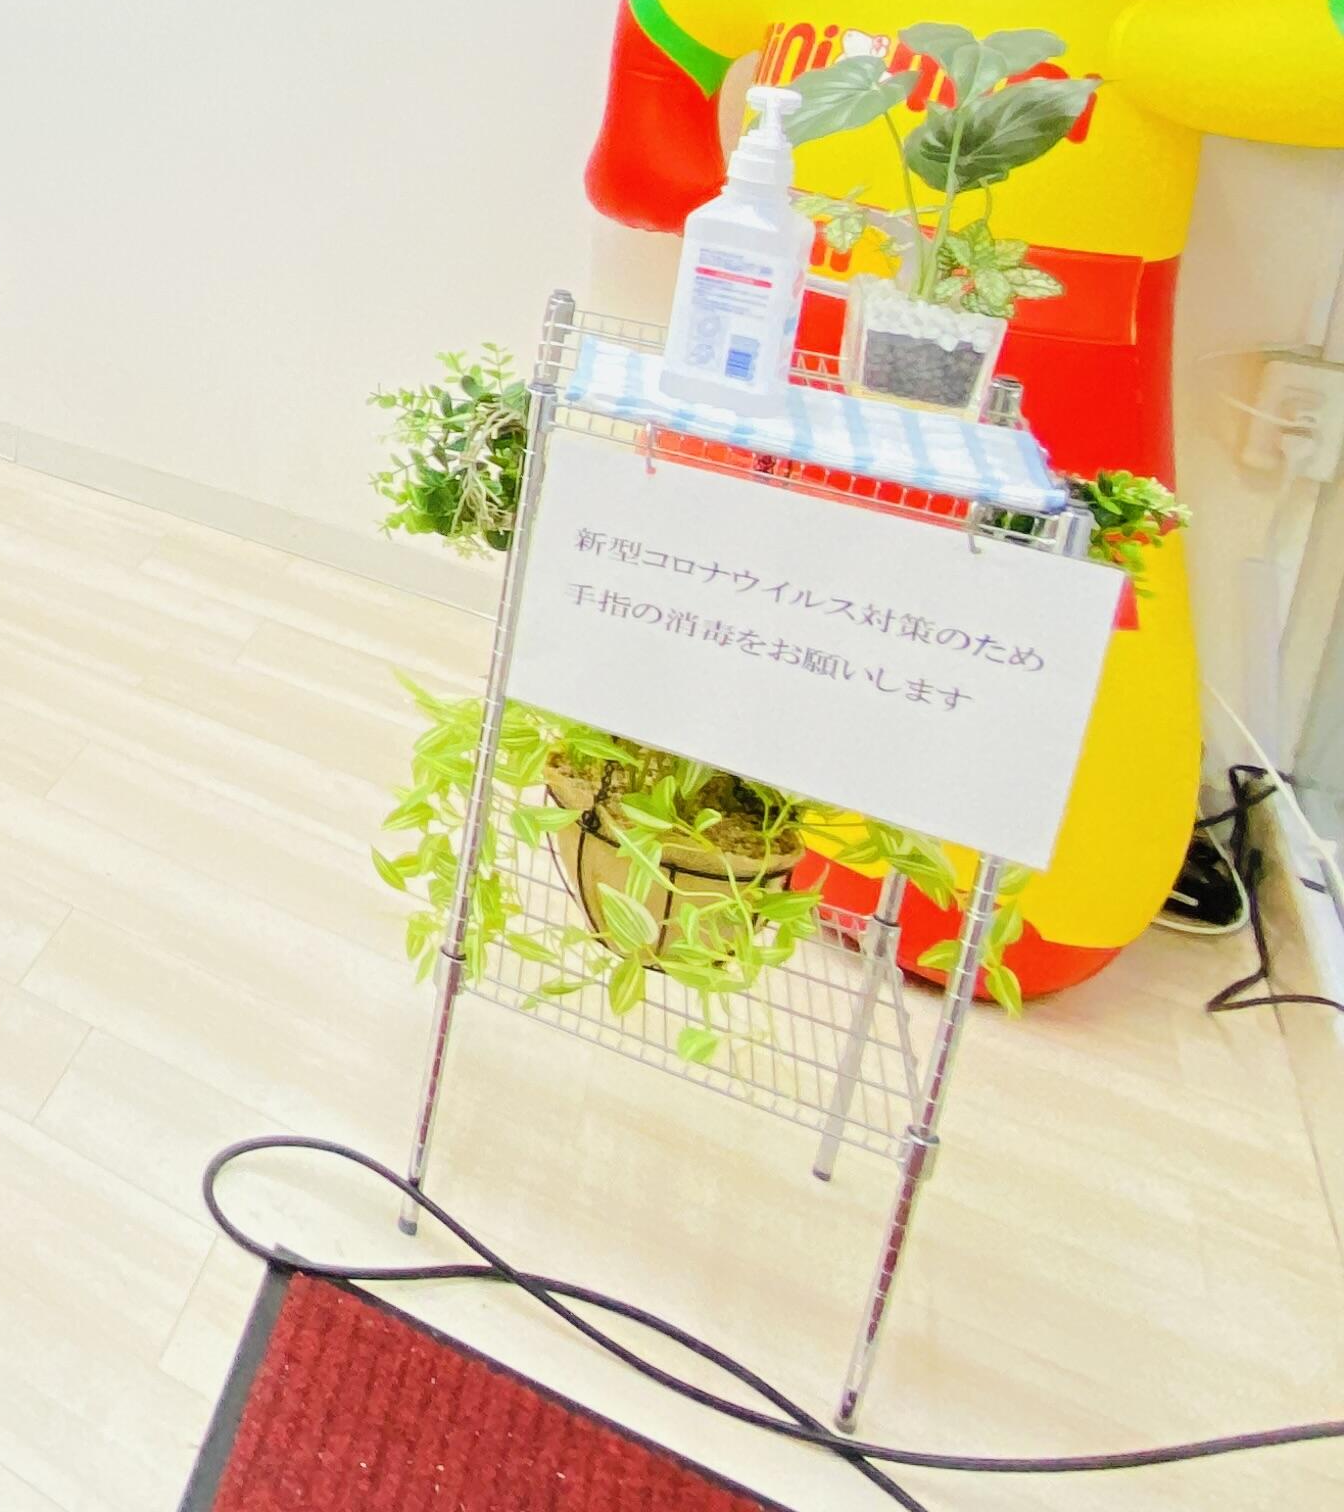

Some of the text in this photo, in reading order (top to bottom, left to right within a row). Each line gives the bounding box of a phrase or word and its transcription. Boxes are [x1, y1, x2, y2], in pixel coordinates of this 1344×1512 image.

[566, 581, 972, 712] 手指の消毒をお願いします
[574, 527, 1046, 673] 新型コロナウイルス対策のため
